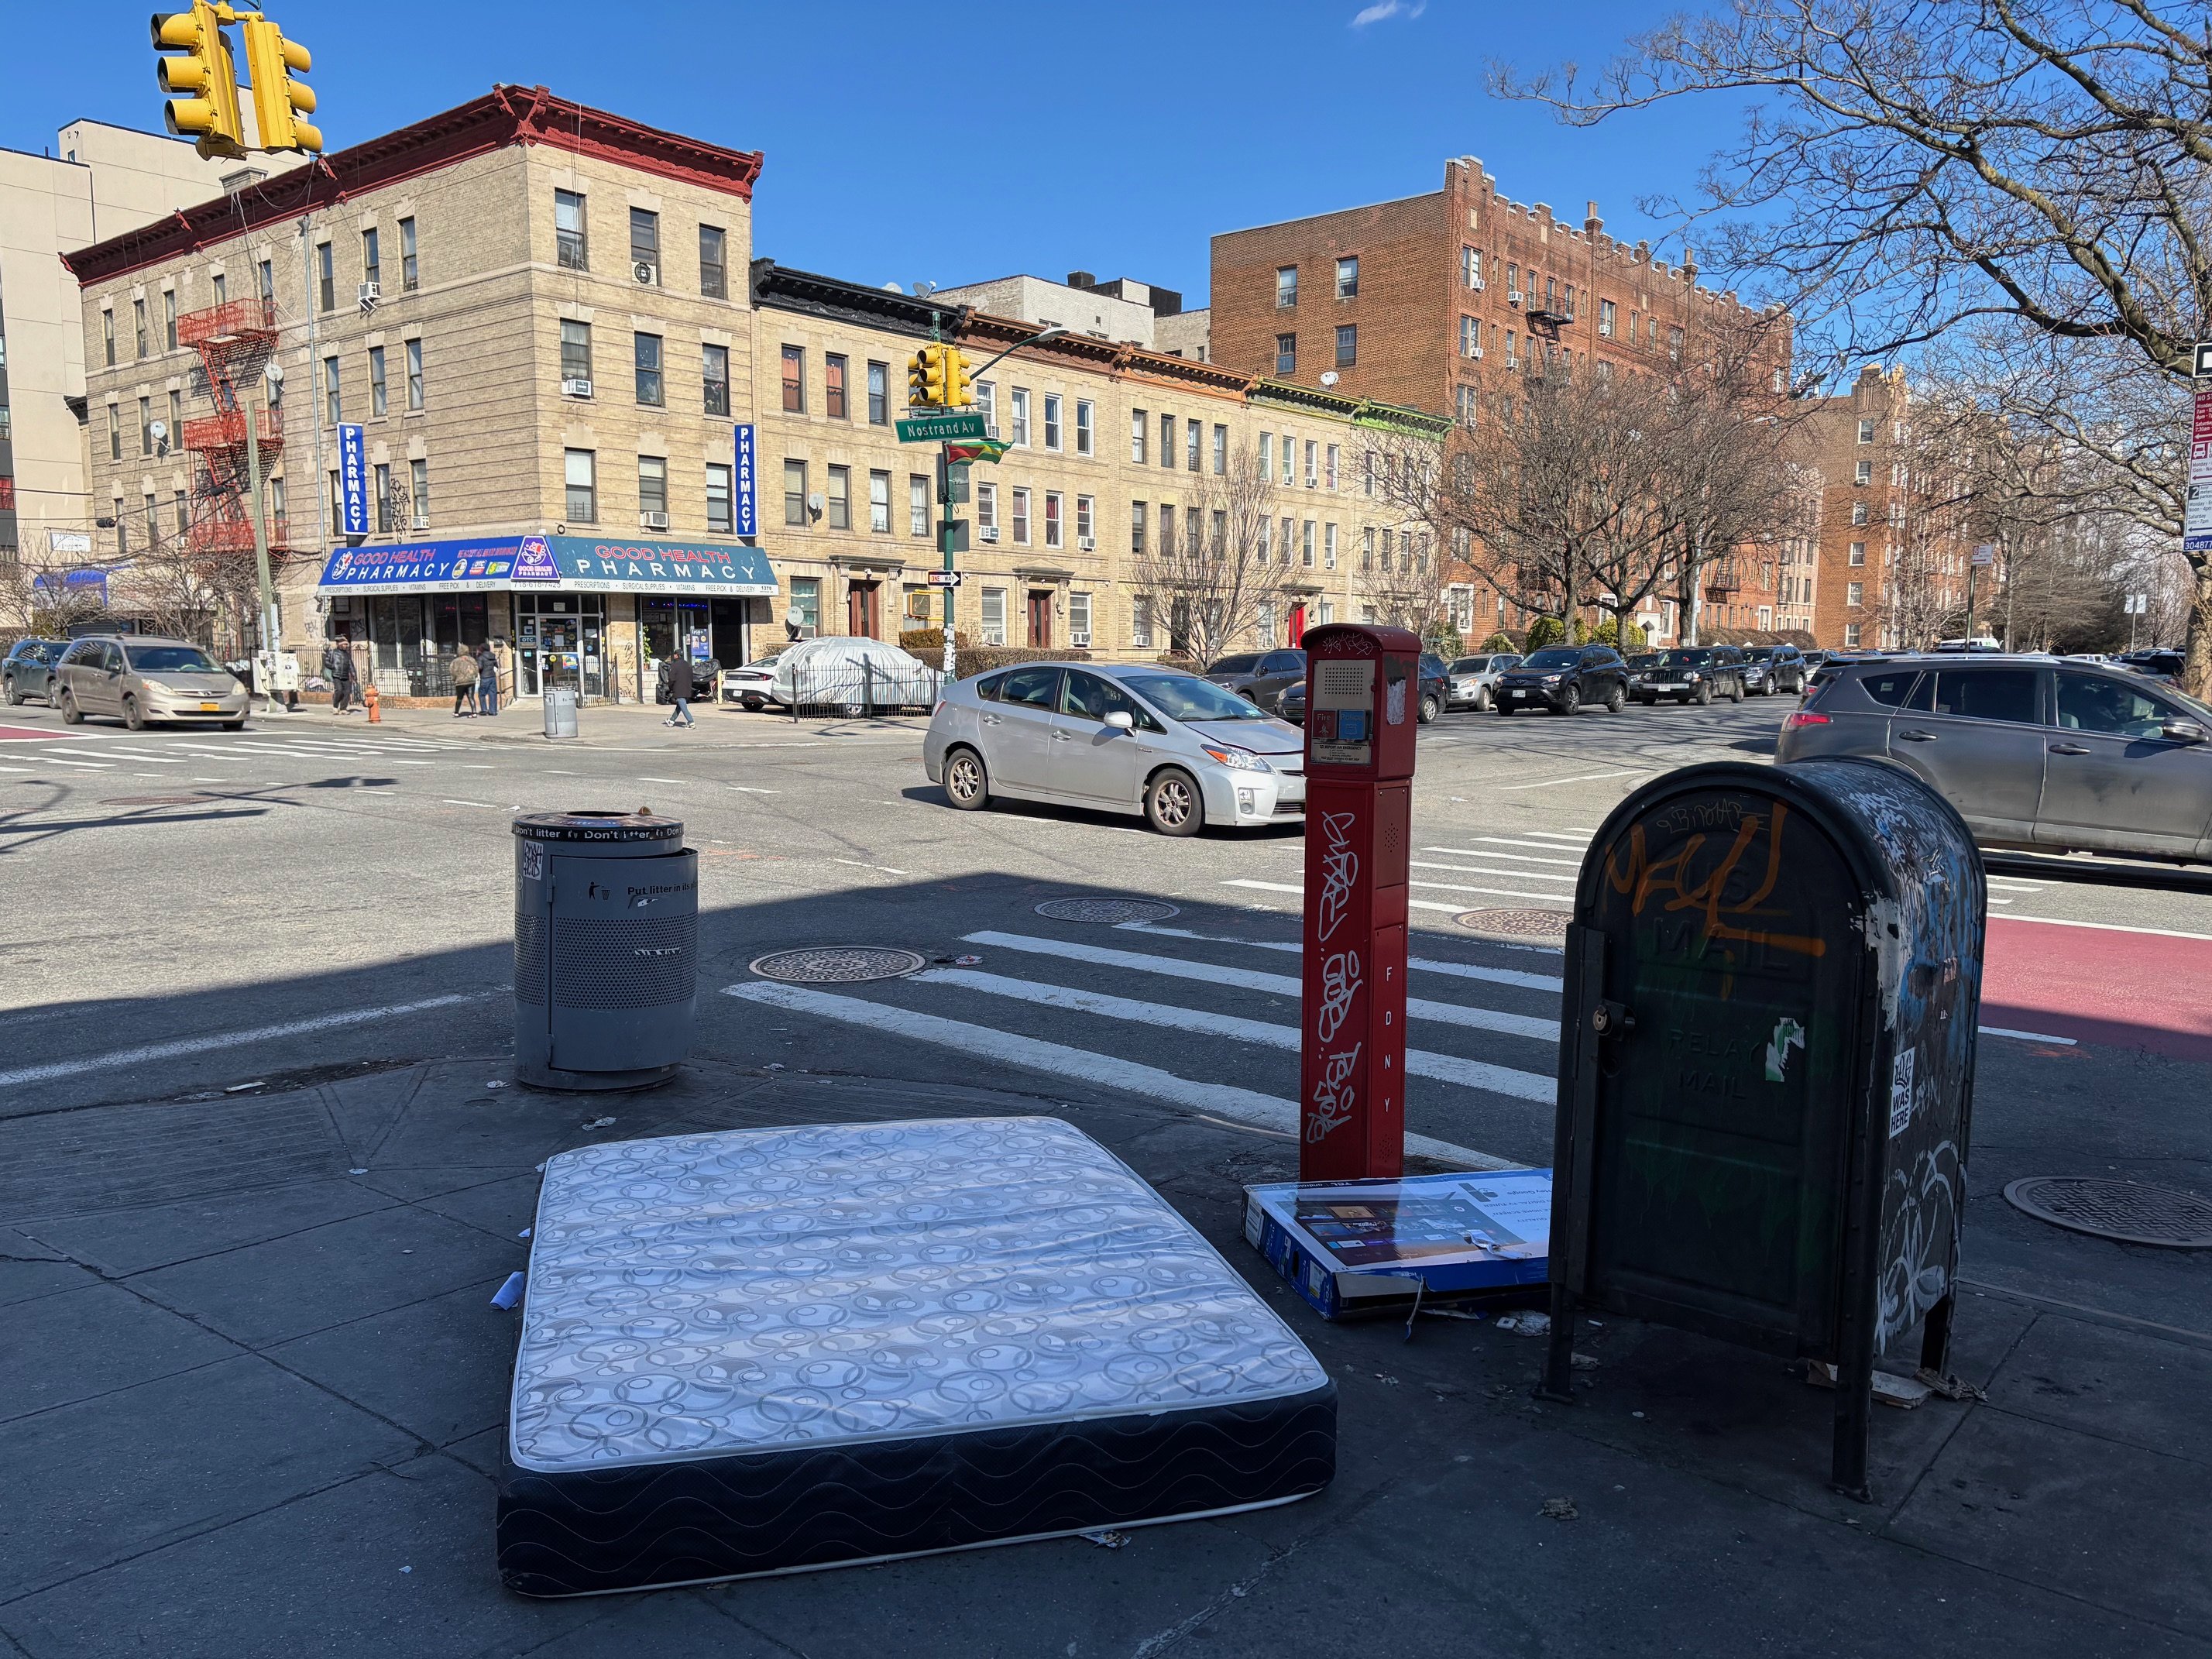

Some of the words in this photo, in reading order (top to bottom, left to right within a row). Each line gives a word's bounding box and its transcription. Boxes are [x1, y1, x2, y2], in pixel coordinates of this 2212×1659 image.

[907, 421, 960, 438] Nostrand
[962, 421, 974, 434] Av
[345, 427, 361, 532] PHARMACY
[740, 427, 751, 533] PHARMACY
[2191, 486, 2199, 499] 2
[353, 551, 389, 565] GOOD
[389, 548, 436, 564] HEALTH
[595, 545, 655, 561] GOOD
[659, 548, 732, 564] HEALTH
[345, 562, 450, 580] PHARMACY
[576, 559, 755, 579] PHARMACY
[515, 826, 533, 836] Don't
[536, 829, 561, 838] litter
[584, 830, 619, 840] Don't
[627, 887, 648, 895] Put
[649, 885, 673, 895] litter
[673, 884, 681, 892] in
[1384, 966, 1393, 1112] FDNY
[1668, 1027, 1760, 1063] RELAY
[1678, 1070, 1747, 1100] MAIL
[1893, 1088, 1910, 1112] WAS
[1891, 1108, 1909, 1133] HERE
